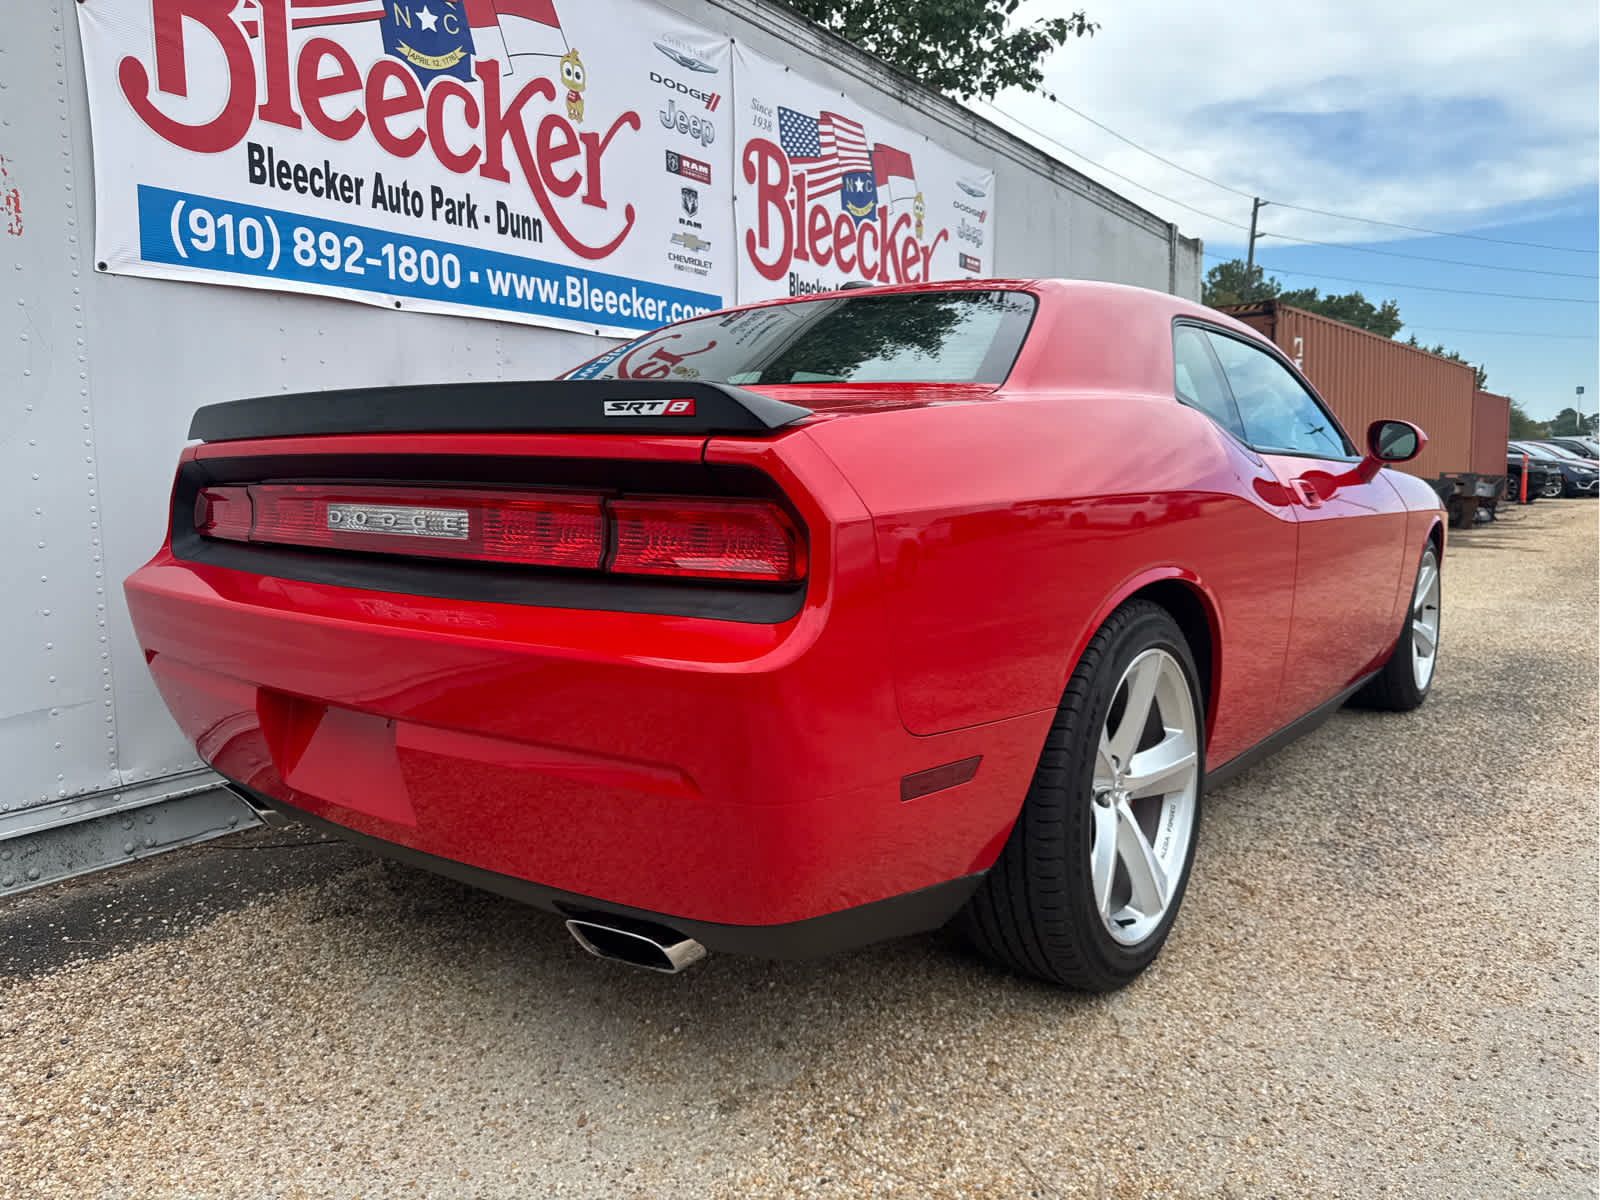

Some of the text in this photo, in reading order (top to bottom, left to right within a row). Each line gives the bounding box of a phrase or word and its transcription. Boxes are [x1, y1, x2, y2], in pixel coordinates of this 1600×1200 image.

[393, 2, 459, 34] N C
[650, 71, 712, 103] DODGE
[660, 99, 715, 147] Jeep
[752, 97, 773, 118] Since
[752, 115, 773, 132] 1938
[118, 0, 641, 260] Bleecker
[682, 160, 709, 174] RAM
[248, 142, 543, 243] Bleecker Auto Park Dunn
[679, 217, 702, 229] RAM
[743, 138, 949, 285] Bleecker
[171, 200, 280, 270] (910)
[293, 227, 461, 289] 892-1800
[667, 252, 713, 269] CHEVROLET
[330, 510, 459, 531] DODGE
